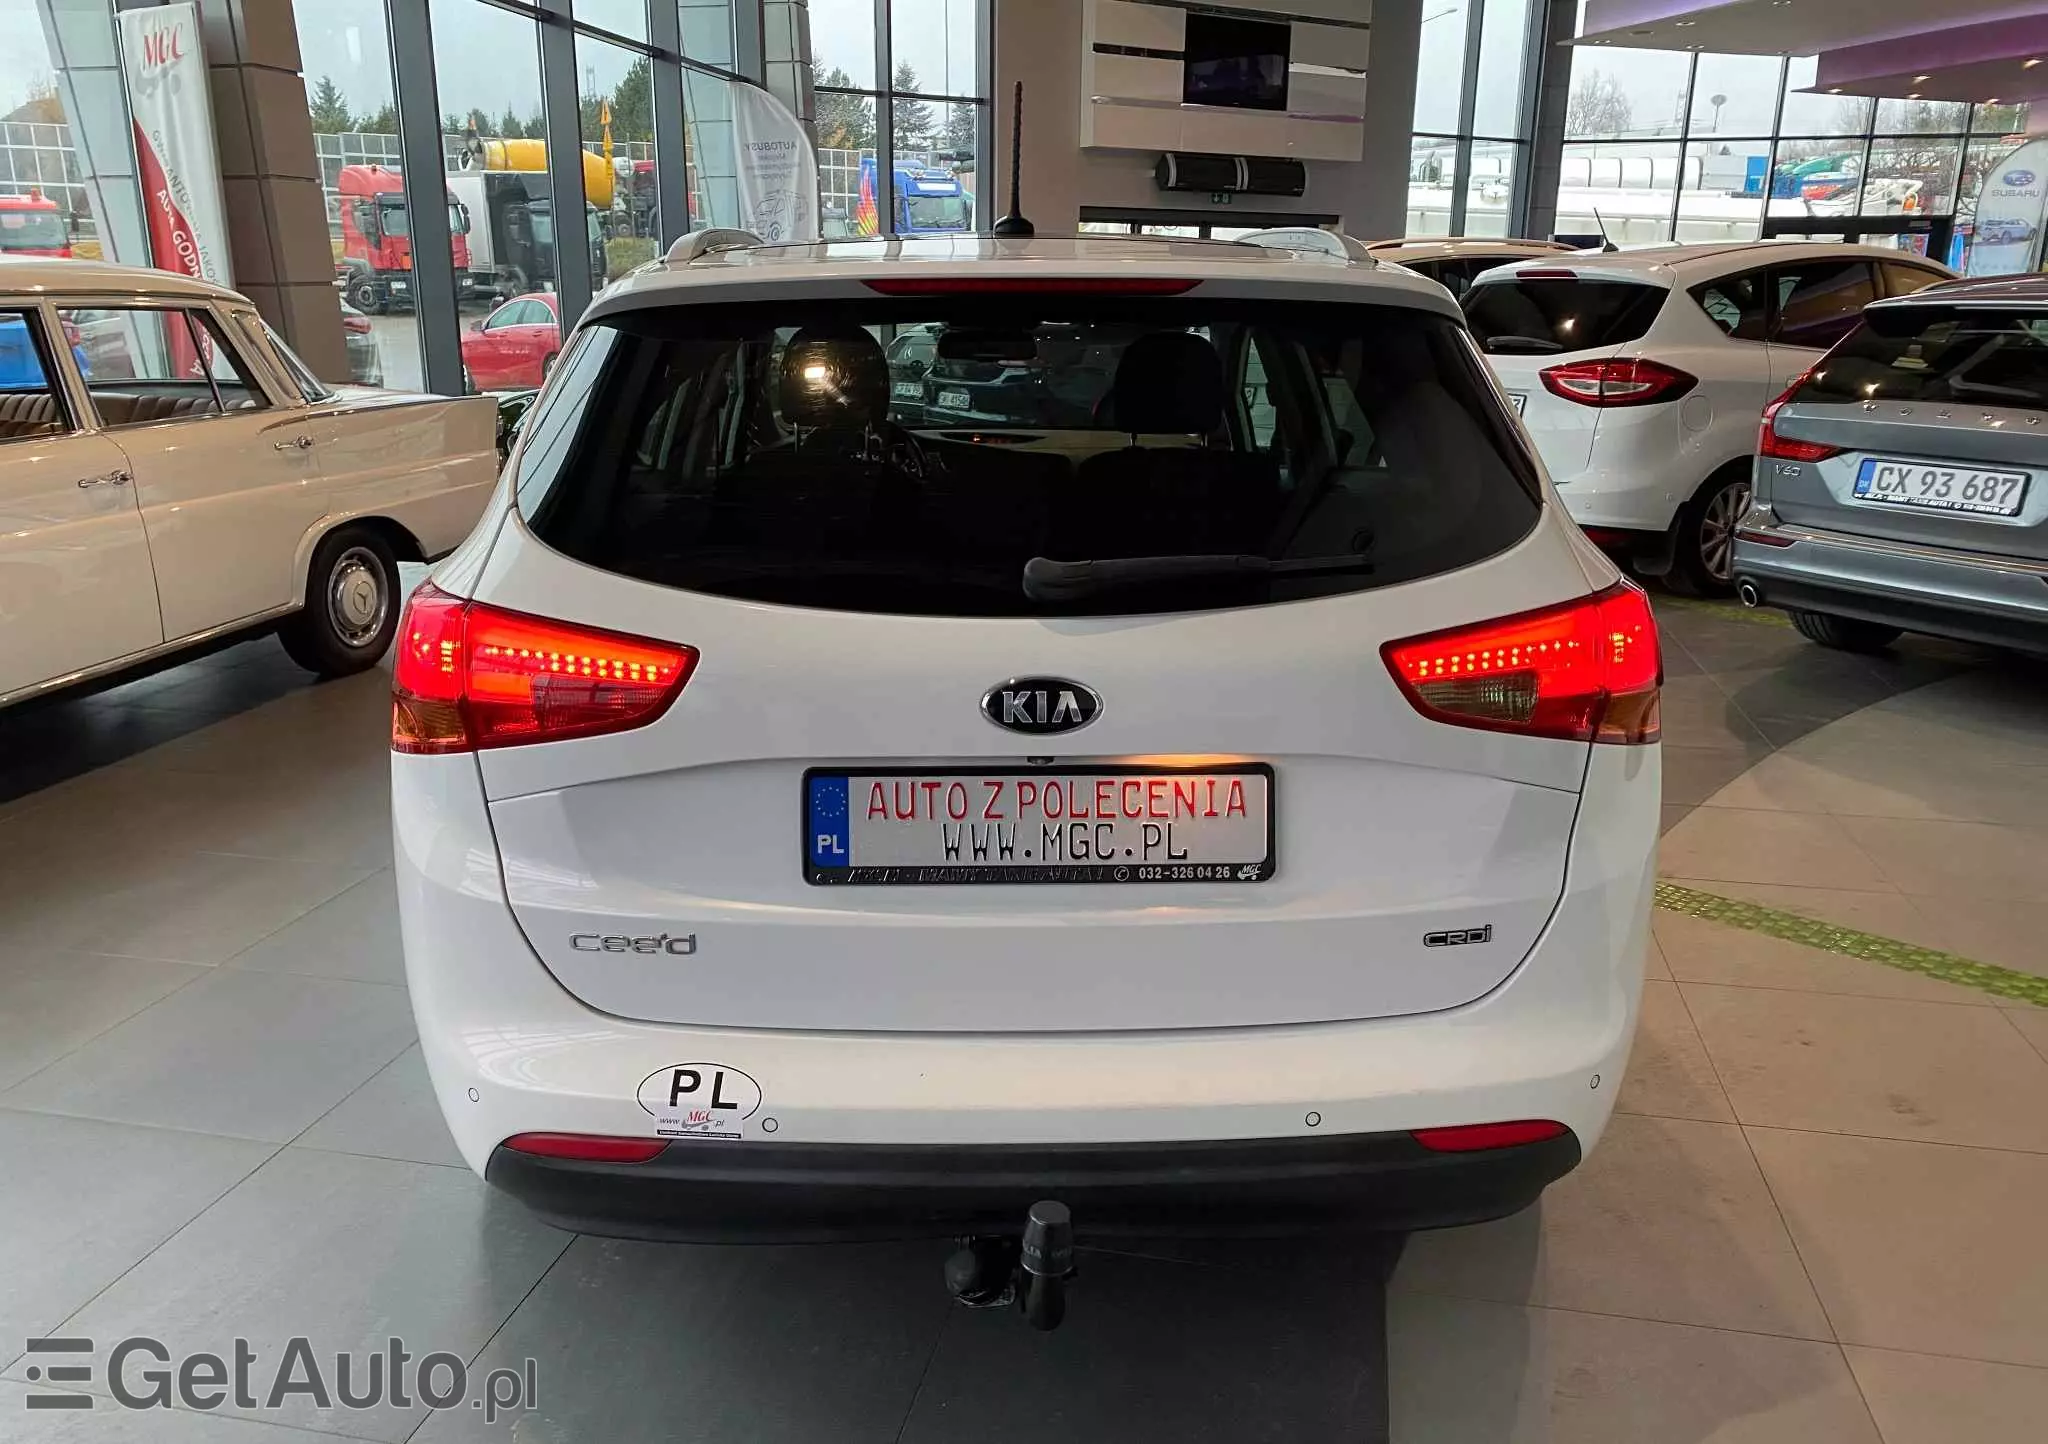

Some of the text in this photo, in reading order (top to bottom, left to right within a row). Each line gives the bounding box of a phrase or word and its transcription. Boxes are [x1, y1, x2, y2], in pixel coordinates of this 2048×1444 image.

[143, 23, 184, 71] MGC
[1991, 189, 2040, 198] SUBARU
[172, 230, 201, 279] GODN
[1775, 464, 1801, 476] V60
[1877, 466, 2020, 504] CX 93 687
[1002, 691, 1082, 723] KIA
[866, 780, 1246, 820] AUTO Z POLECENIA
[817, 834, 844, 854] PL
[941, 822, 1188, 861] WWW.MGC.PL
[1139, 866, 1230, 879] 032-326 04 26
[669, 1069, 738, 1109] PL
